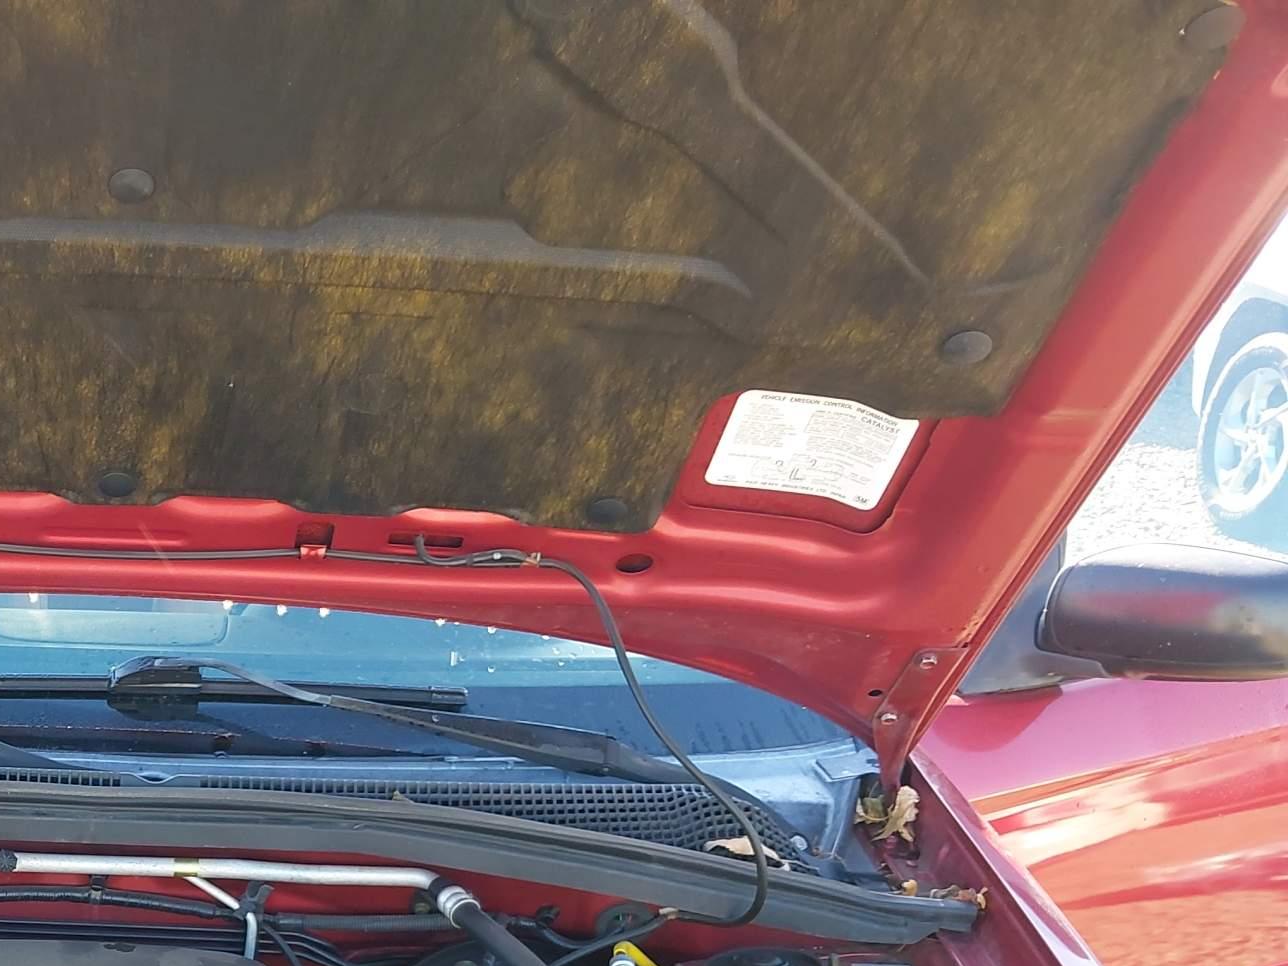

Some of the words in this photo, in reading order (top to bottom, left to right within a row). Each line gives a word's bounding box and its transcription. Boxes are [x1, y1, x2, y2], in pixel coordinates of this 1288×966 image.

[823, 401, 853, 410] CONTROL
[856, 407, 898, 427] INFORMATION
[861, 416, 900, 434] CATALYST
